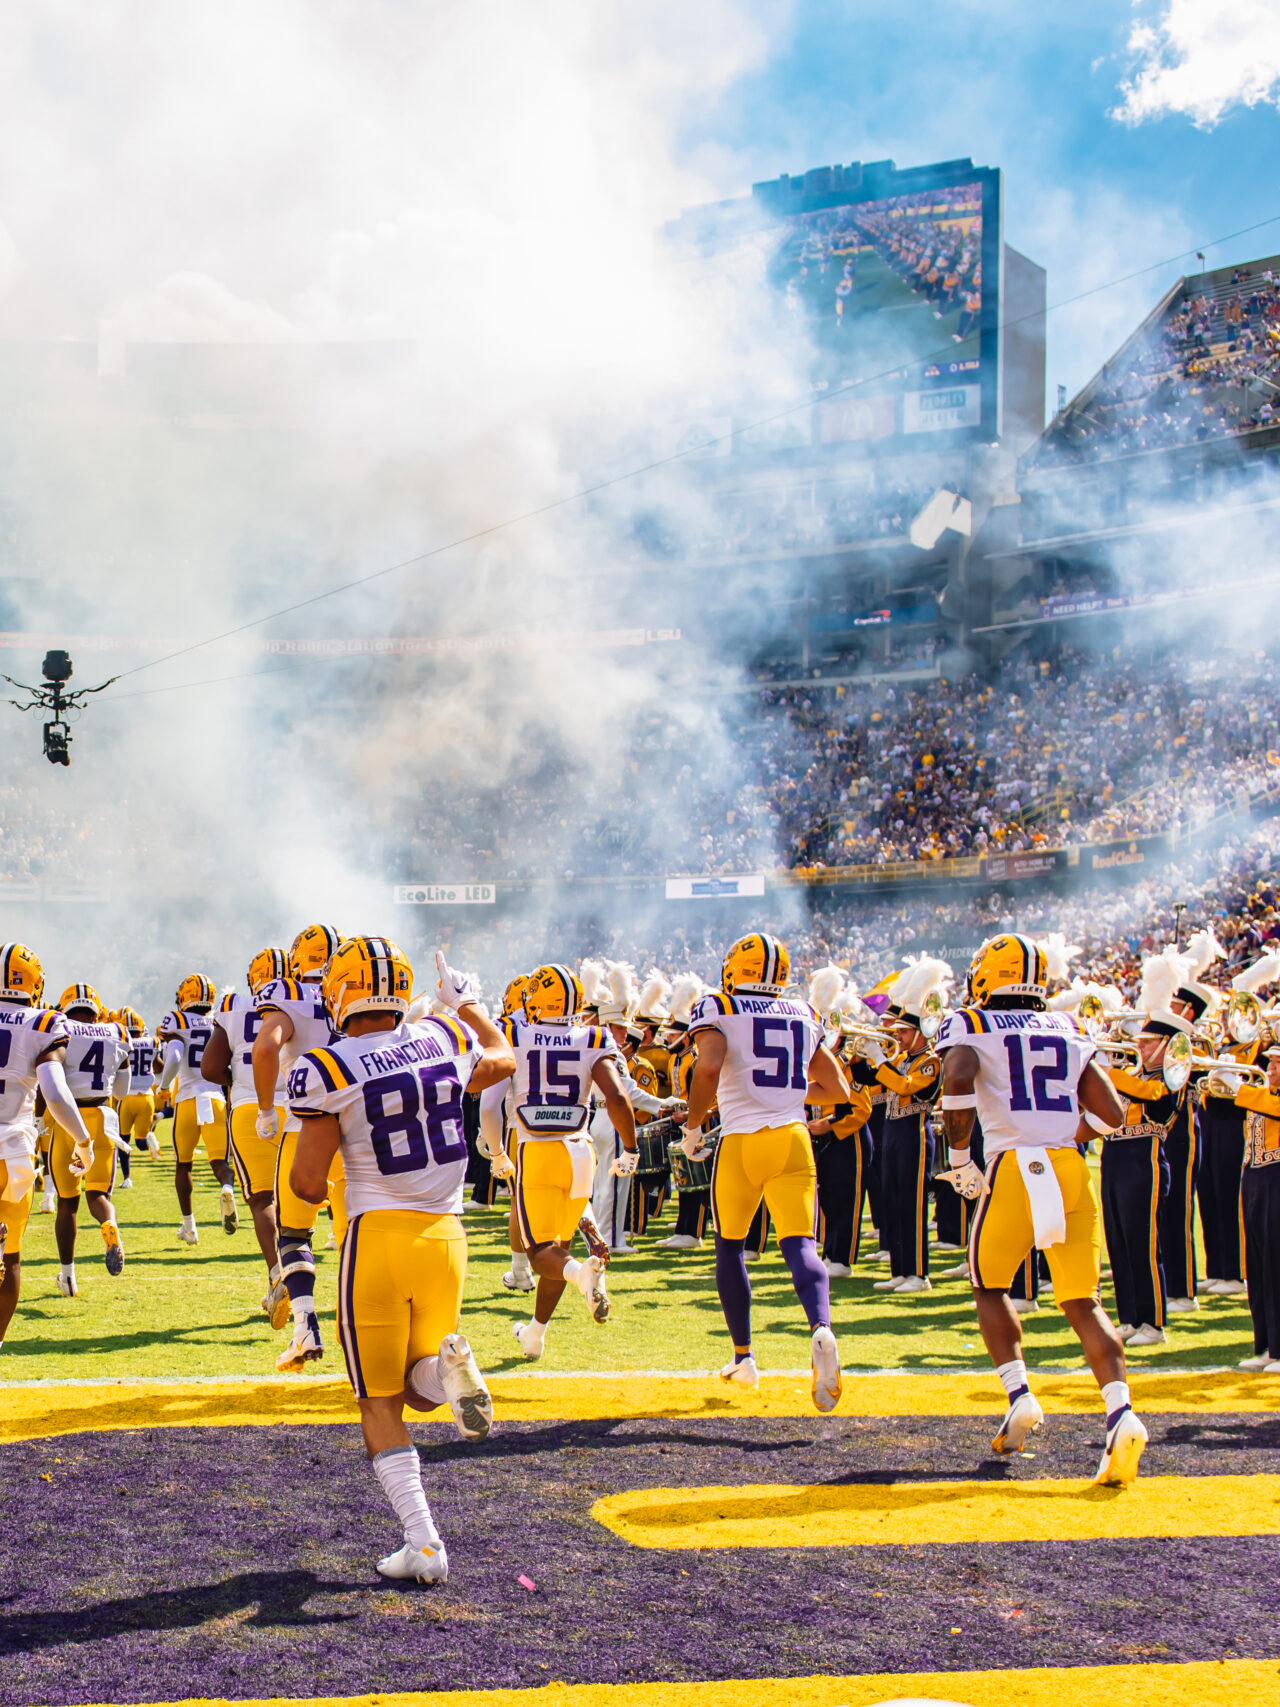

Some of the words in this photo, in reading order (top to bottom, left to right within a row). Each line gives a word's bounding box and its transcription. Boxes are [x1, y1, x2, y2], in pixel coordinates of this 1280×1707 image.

[1052, 604, 1076, 615] NEED
[646, 628, 681, 641] LSU
[285, 640, 331, 651] Radio
[335, 640, 394, 652] Station
[399, 640, 421, 652] for
[398, 887, 457, 903] EcoLite
[465, 886, 492, 901] LED
[1011, 984, 1045, 994] TIGERS
[366, 997, 401, 1005] TIGERS
[992, 1013, 1042, 1029] DAVIS
[73, 1025, 112, 1038] HARRIS
[534, 1033, 572, 1046] RYAN
[359, 1036, 445, 1077] FRANCIONI
[752, 1017, 807, 1090] 51
[79, 1041, 105, 1091] 4
[526, 1050, 581, 1107] 15
[1004, 1034, 1074, 1113] 12
[362, 1062, 469, 1176] 88
[534, 1111, 573, 1121] DOUGLAS
